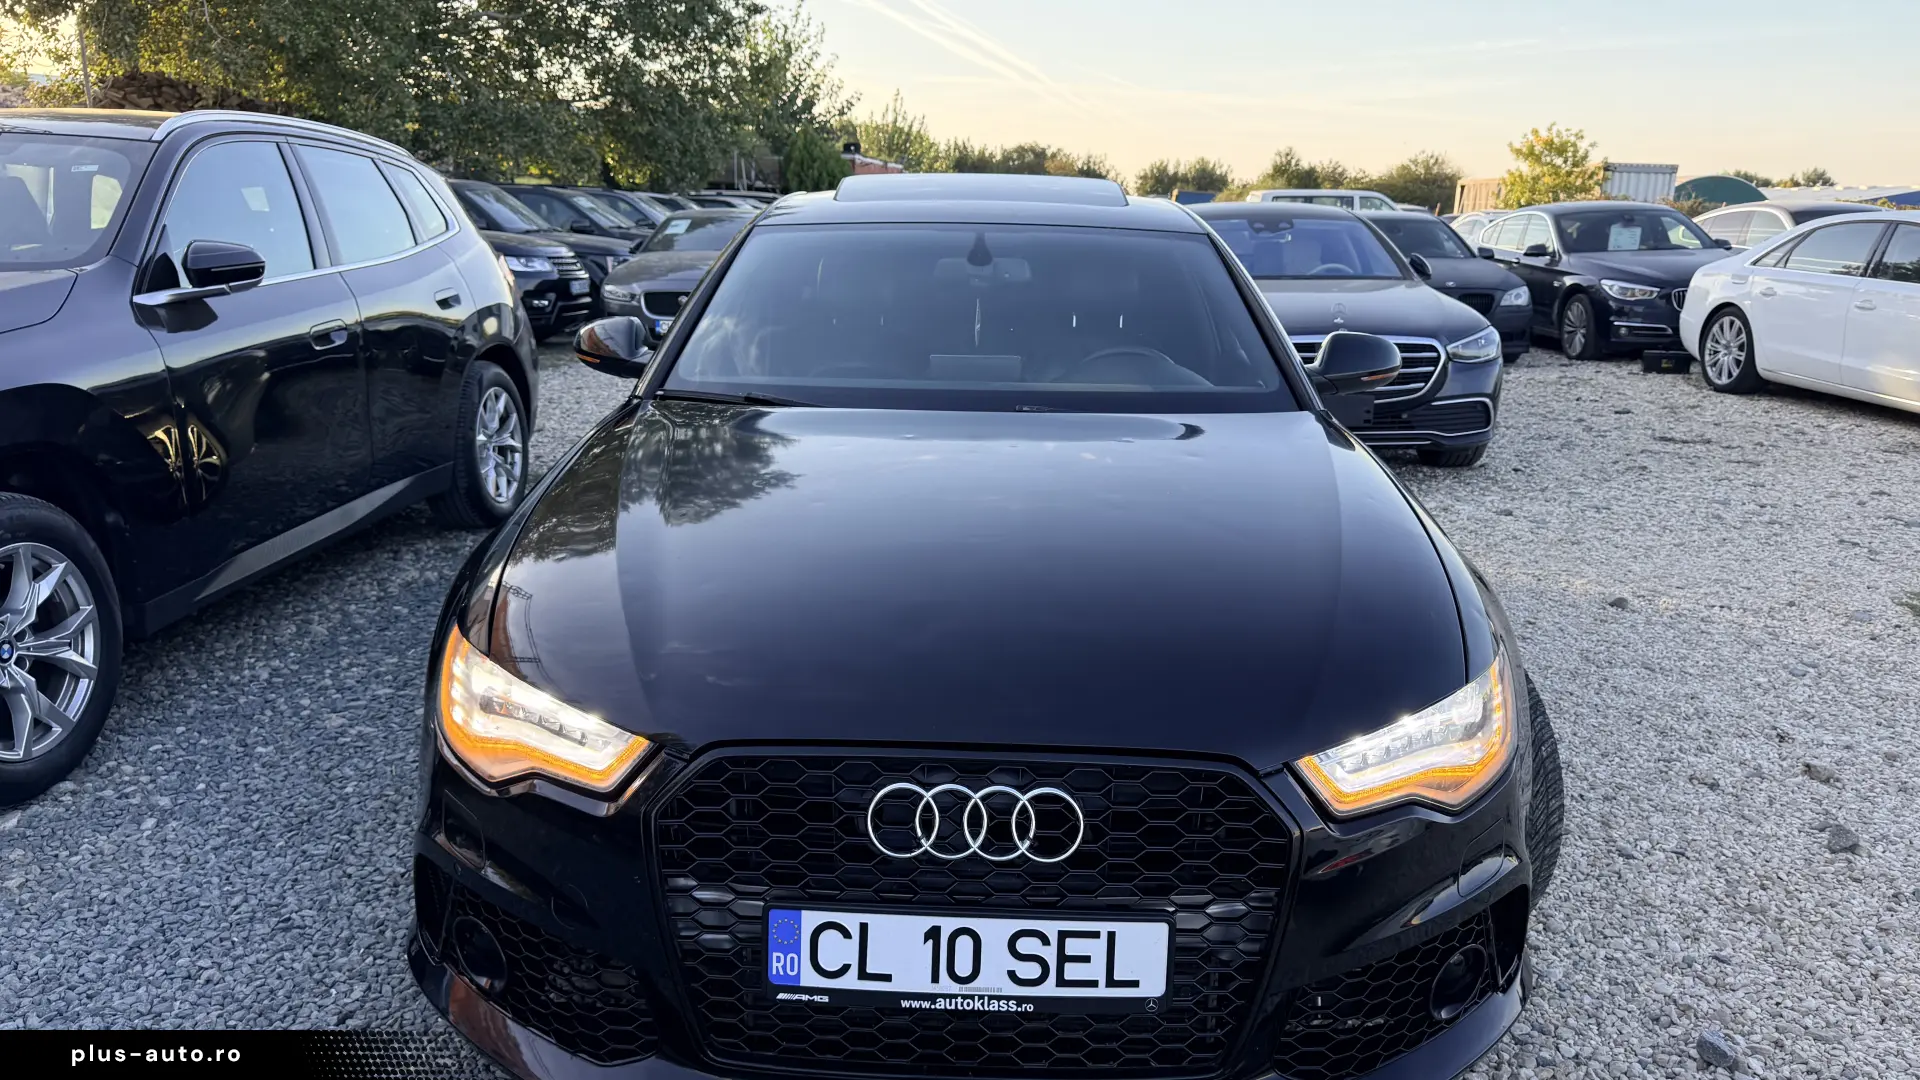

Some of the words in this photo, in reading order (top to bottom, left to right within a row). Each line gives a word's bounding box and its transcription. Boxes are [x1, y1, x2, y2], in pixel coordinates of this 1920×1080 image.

[772, 952, 799, 976] RO
[809, 920, 893, 983] CL
[923, 924, 983, 986] 10
[1006, 928, 1140, 989] SEL
[793, 994, 829, 1003] AMG
[900, 994, 1034, 1013] www.autoklass.ro
